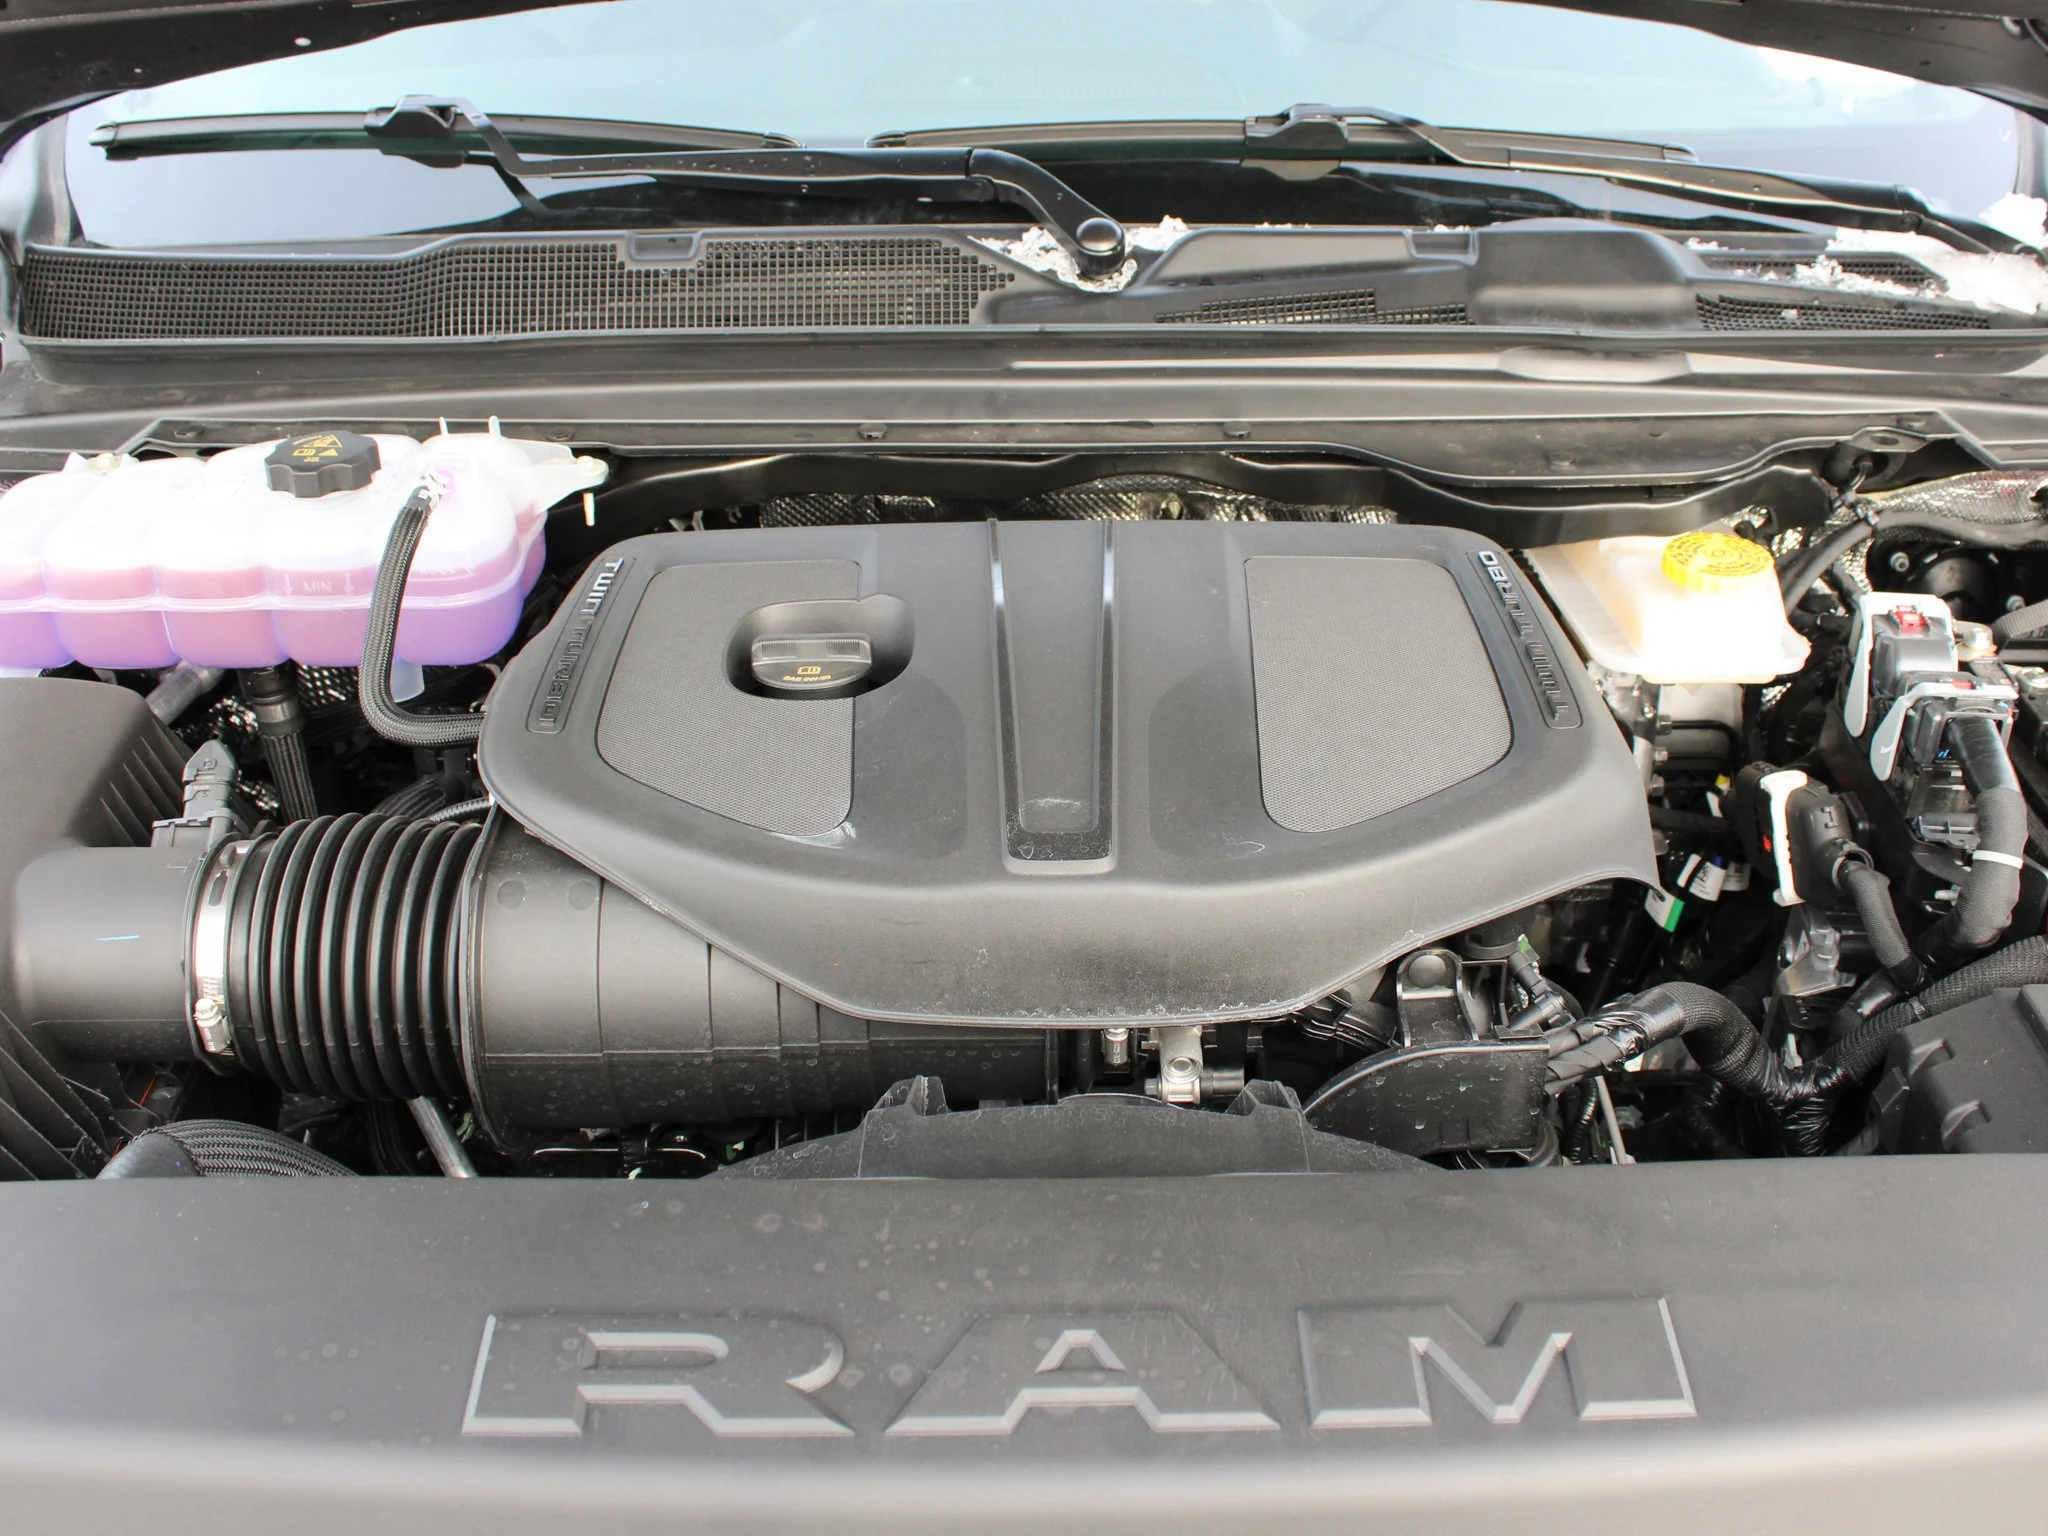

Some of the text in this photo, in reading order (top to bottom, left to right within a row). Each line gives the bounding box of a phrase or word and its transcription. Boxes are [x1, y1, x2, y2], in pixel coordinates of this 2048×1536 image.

[302, 580, 332, 593] MIN
[538, 557, 625, 728] TWIN TURBO
[461, 1297, 1698, 1437] RAM
